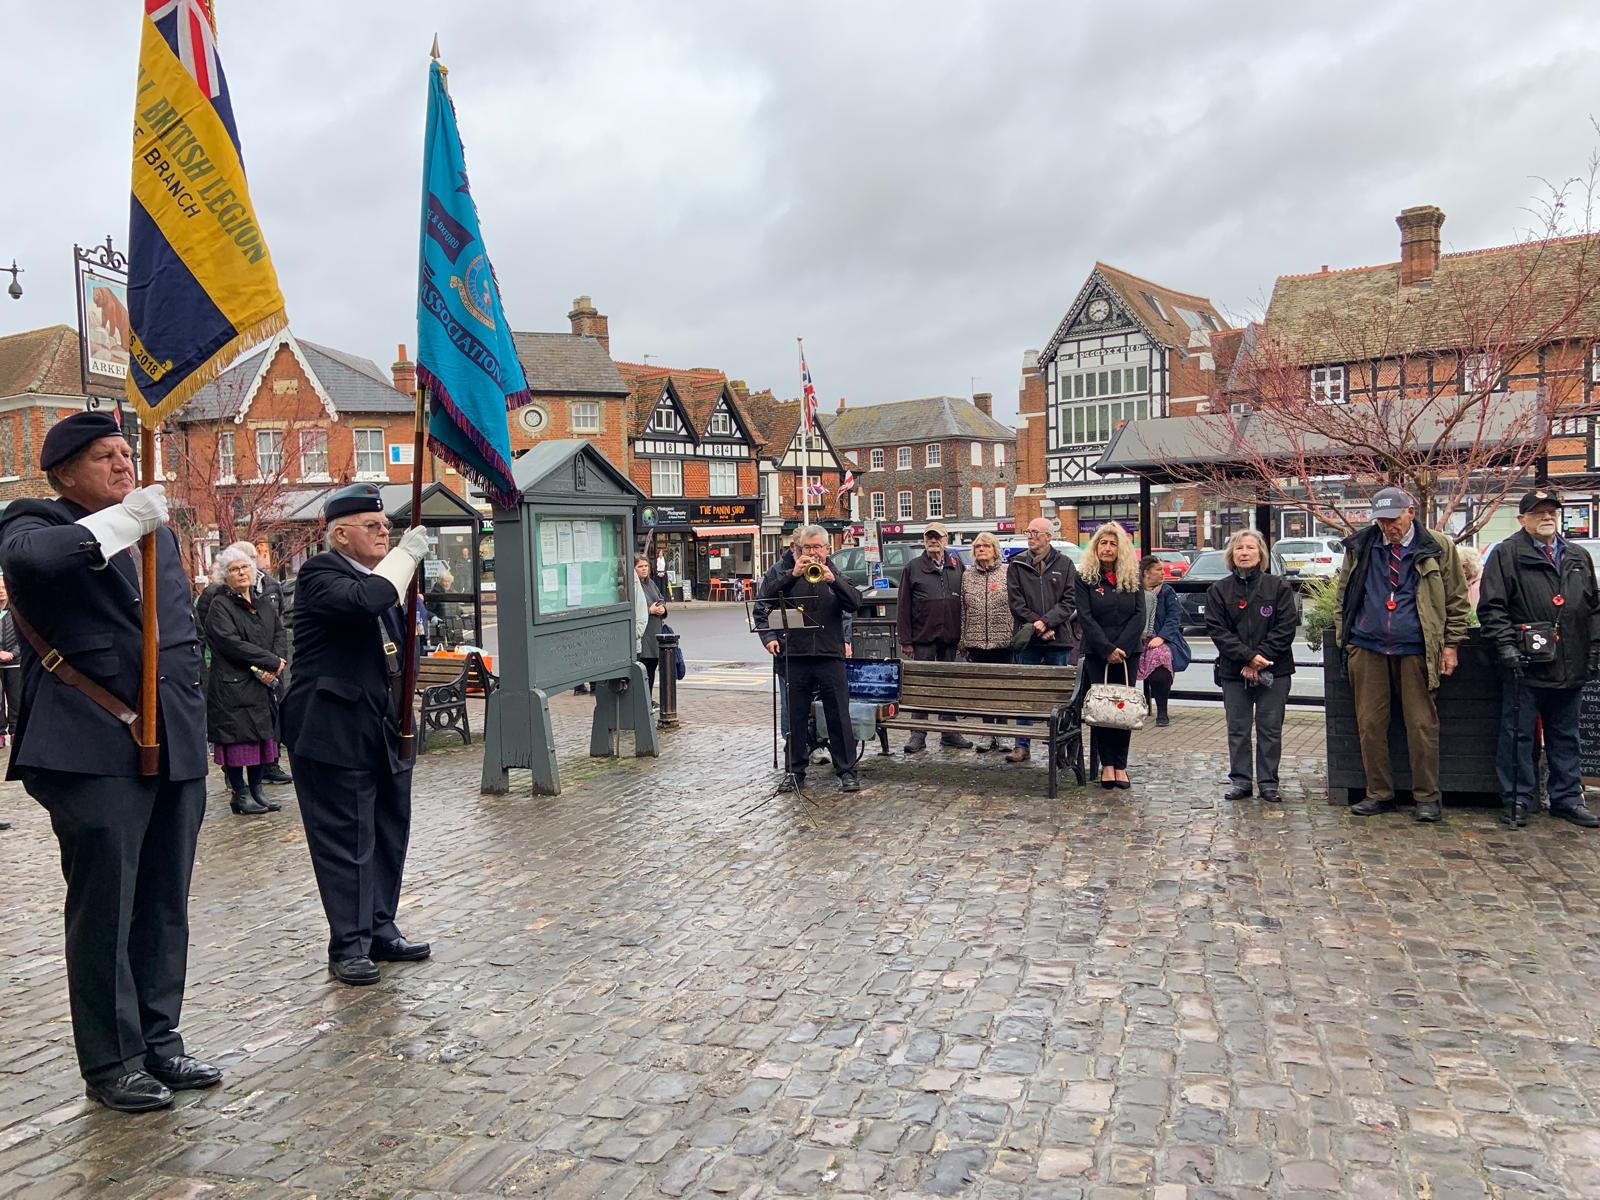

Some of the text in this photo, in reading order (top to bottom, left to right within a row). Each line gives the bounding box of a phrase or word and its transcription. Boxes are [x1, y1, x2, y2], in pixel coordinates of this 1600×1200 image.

[141, 95, 266, 264] BRITISH LEGION
[143, 147, 202, 219] BRANCH
[437, 221, 460, 249] OXFORD
[420, 283, 503, 383] ASSOCIATION
[92, 361, 126, 376] ARKEL
[136, 349, 158, 376] 2018
[700, 505, 746, 516] THE PANINI SHOP
